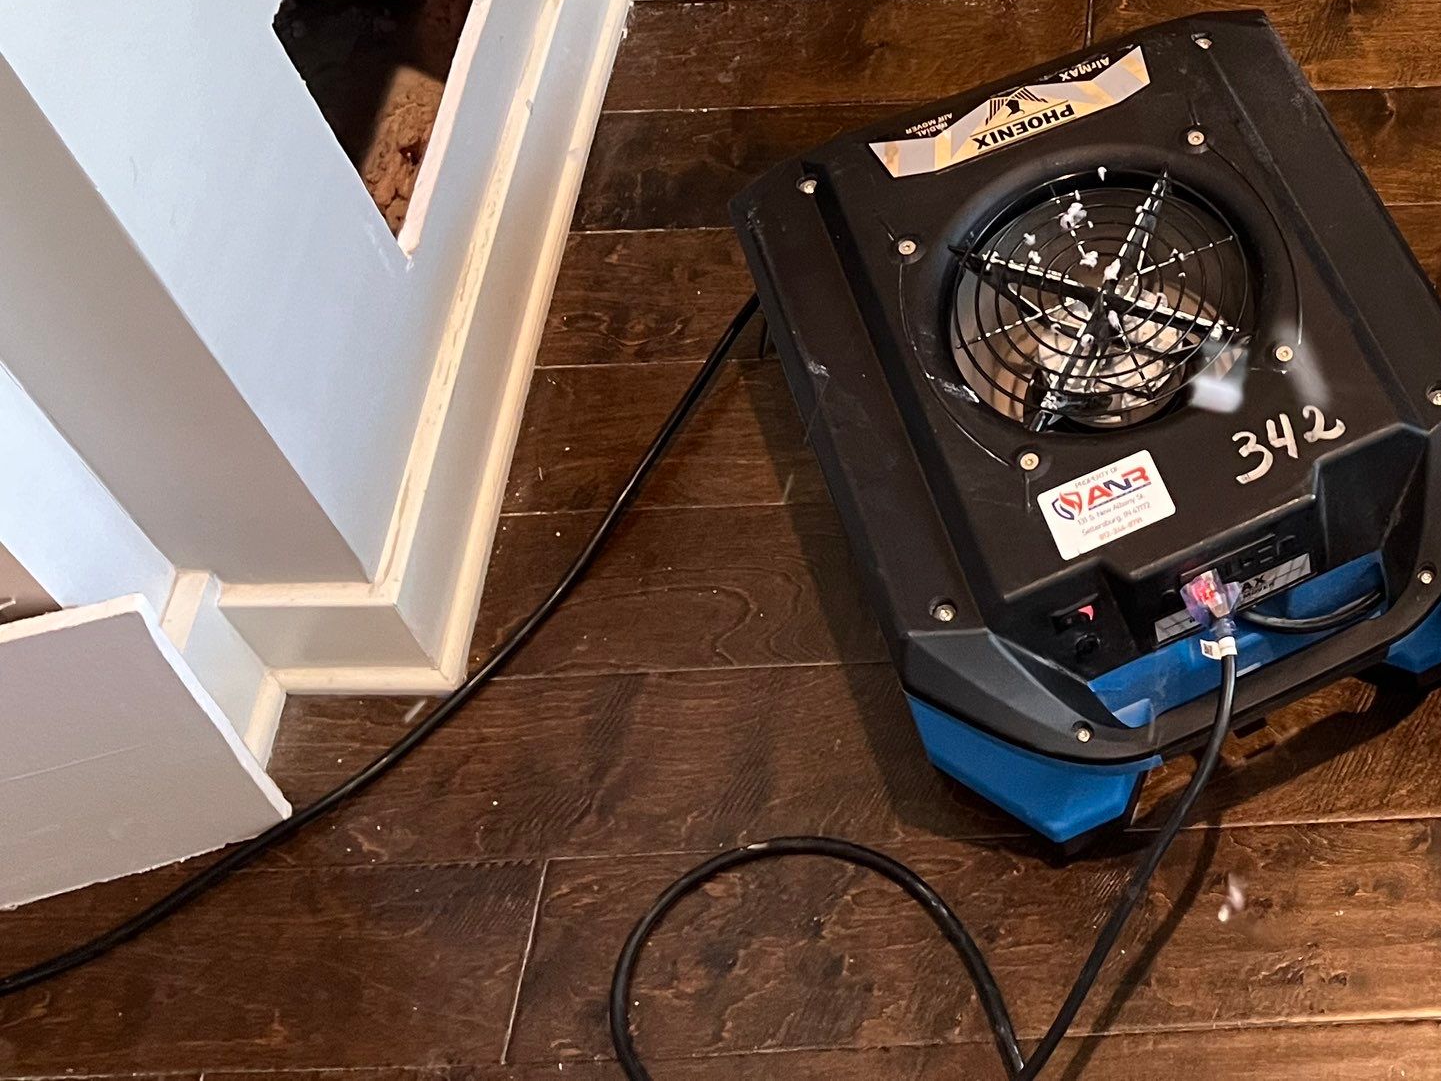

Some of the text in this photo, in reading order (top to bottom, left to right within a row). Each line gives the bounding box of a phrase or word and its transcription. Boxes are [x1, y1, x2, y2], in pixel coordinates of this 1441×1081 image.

[904, 116, 936, 135] MOVER
[972, 103, 1075, 150] PHOENIX
[1231, 404, 1347, 486] 342
[1087, 466, 1152, 506] ANR
[1097, 506, 1112, 518] New
[1113, 497, 1136, 512] Albany
